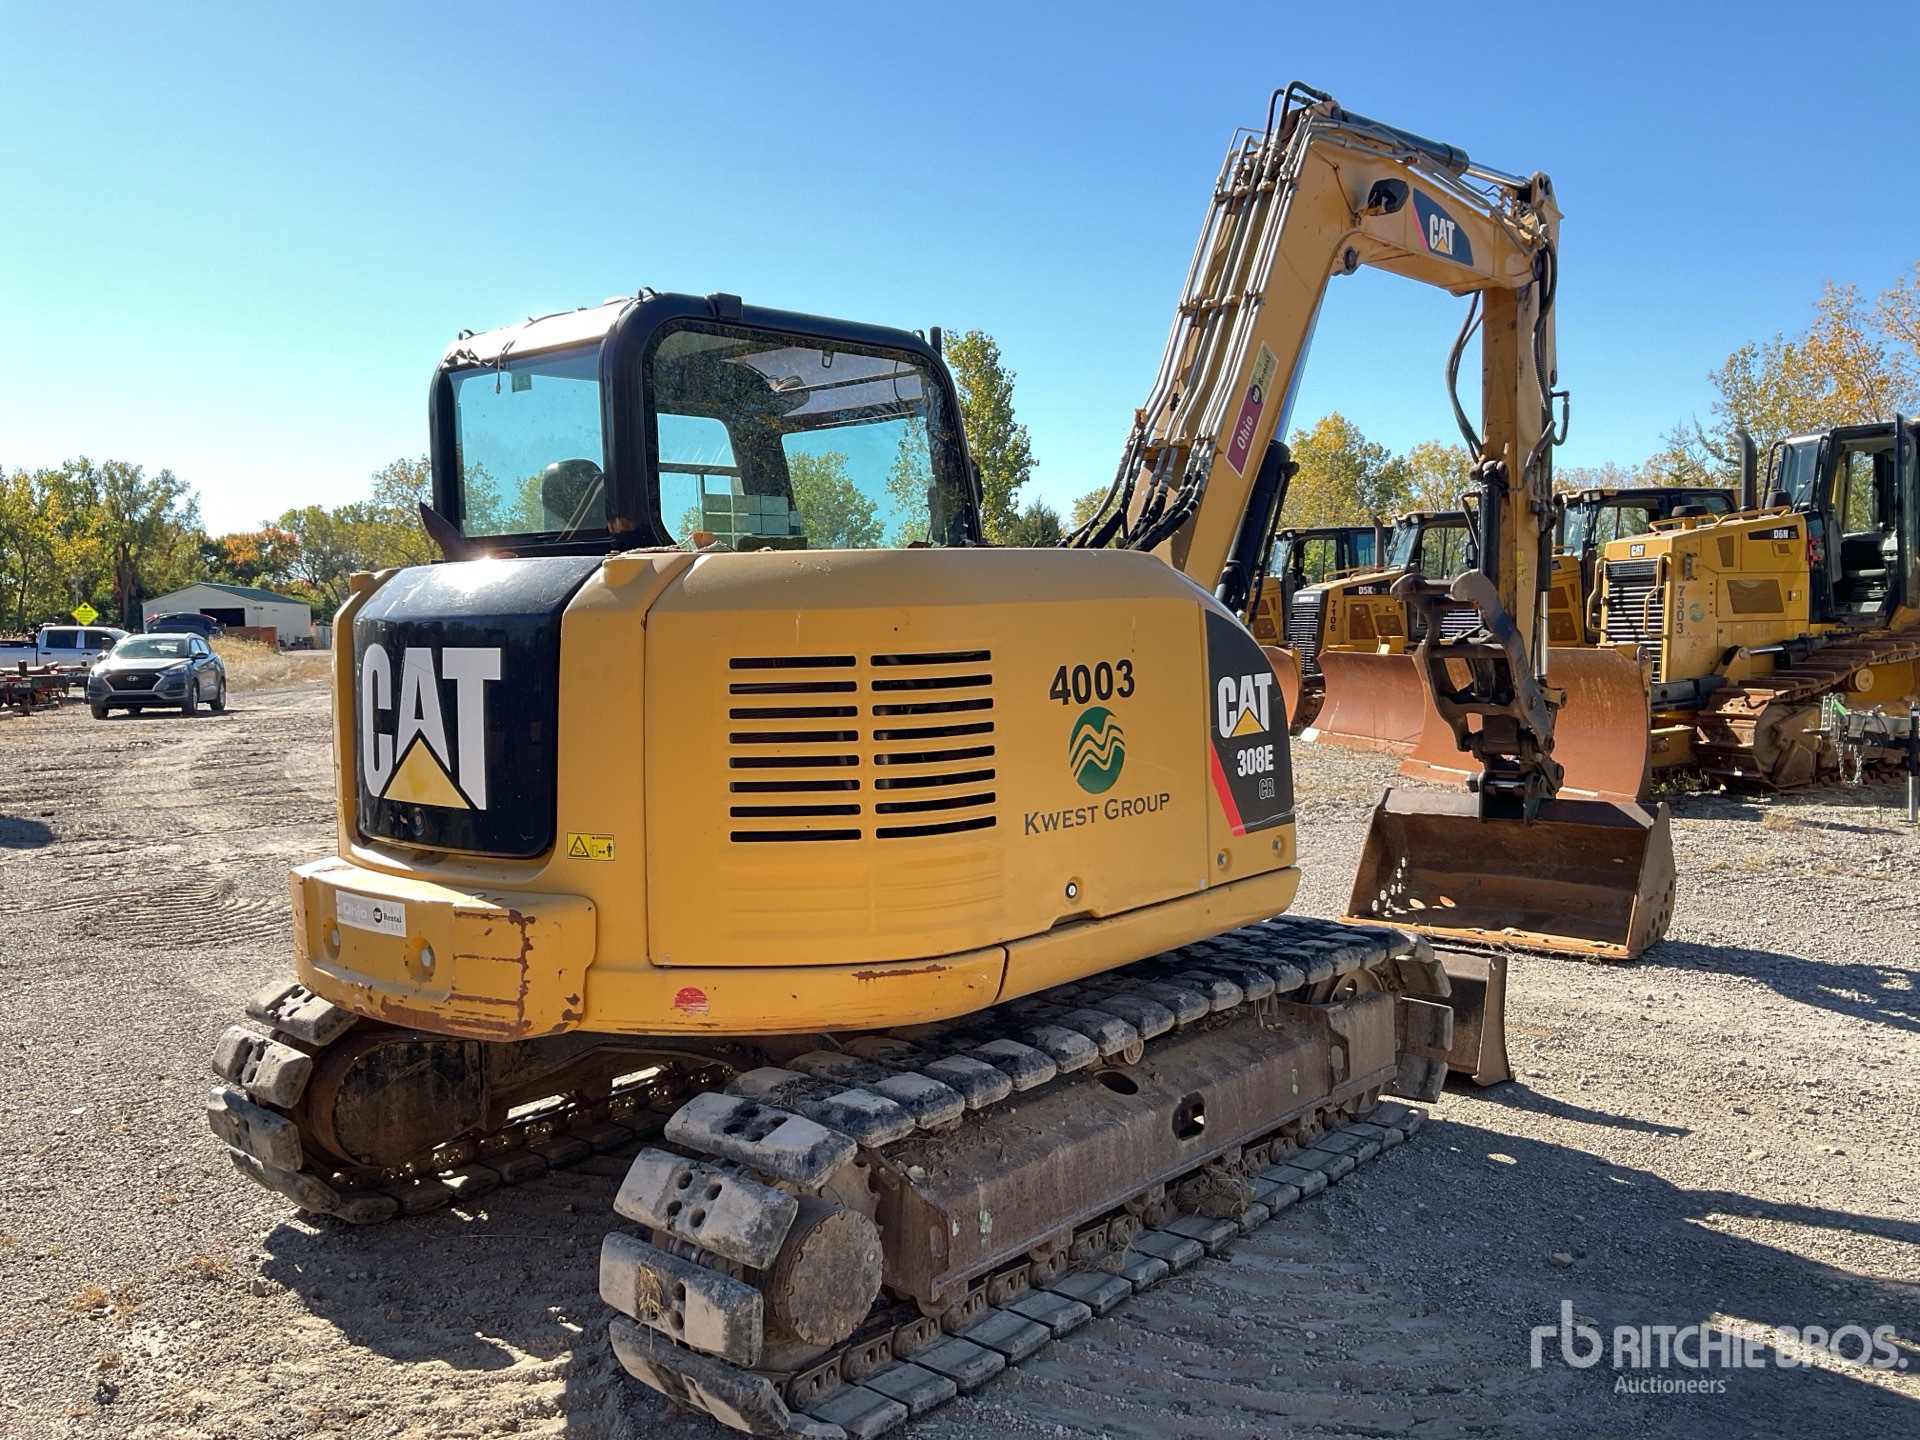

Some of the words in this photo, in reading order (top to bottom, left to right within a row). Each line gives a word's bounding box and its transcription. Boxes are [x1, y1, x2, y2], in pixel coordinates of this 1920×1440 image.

[1429, 213, 1455, 256] CAT
[1236, 415, 1254, 450] Ohio
[1630, 544, 1645, 557] CAT
[1773, 529, 1789, 539] D6N
[1676, 585, 1686, 635] 7303
[1049, 658, 1135, 706] 4003
[1217, 672, 1272, 738] CAT
[362, 643, 501, 811] CAT
[1236, 744, 1274, 777] 308E
[1258, 778, 1275, 800] CR
[383, 912, 402, 923] Rental
